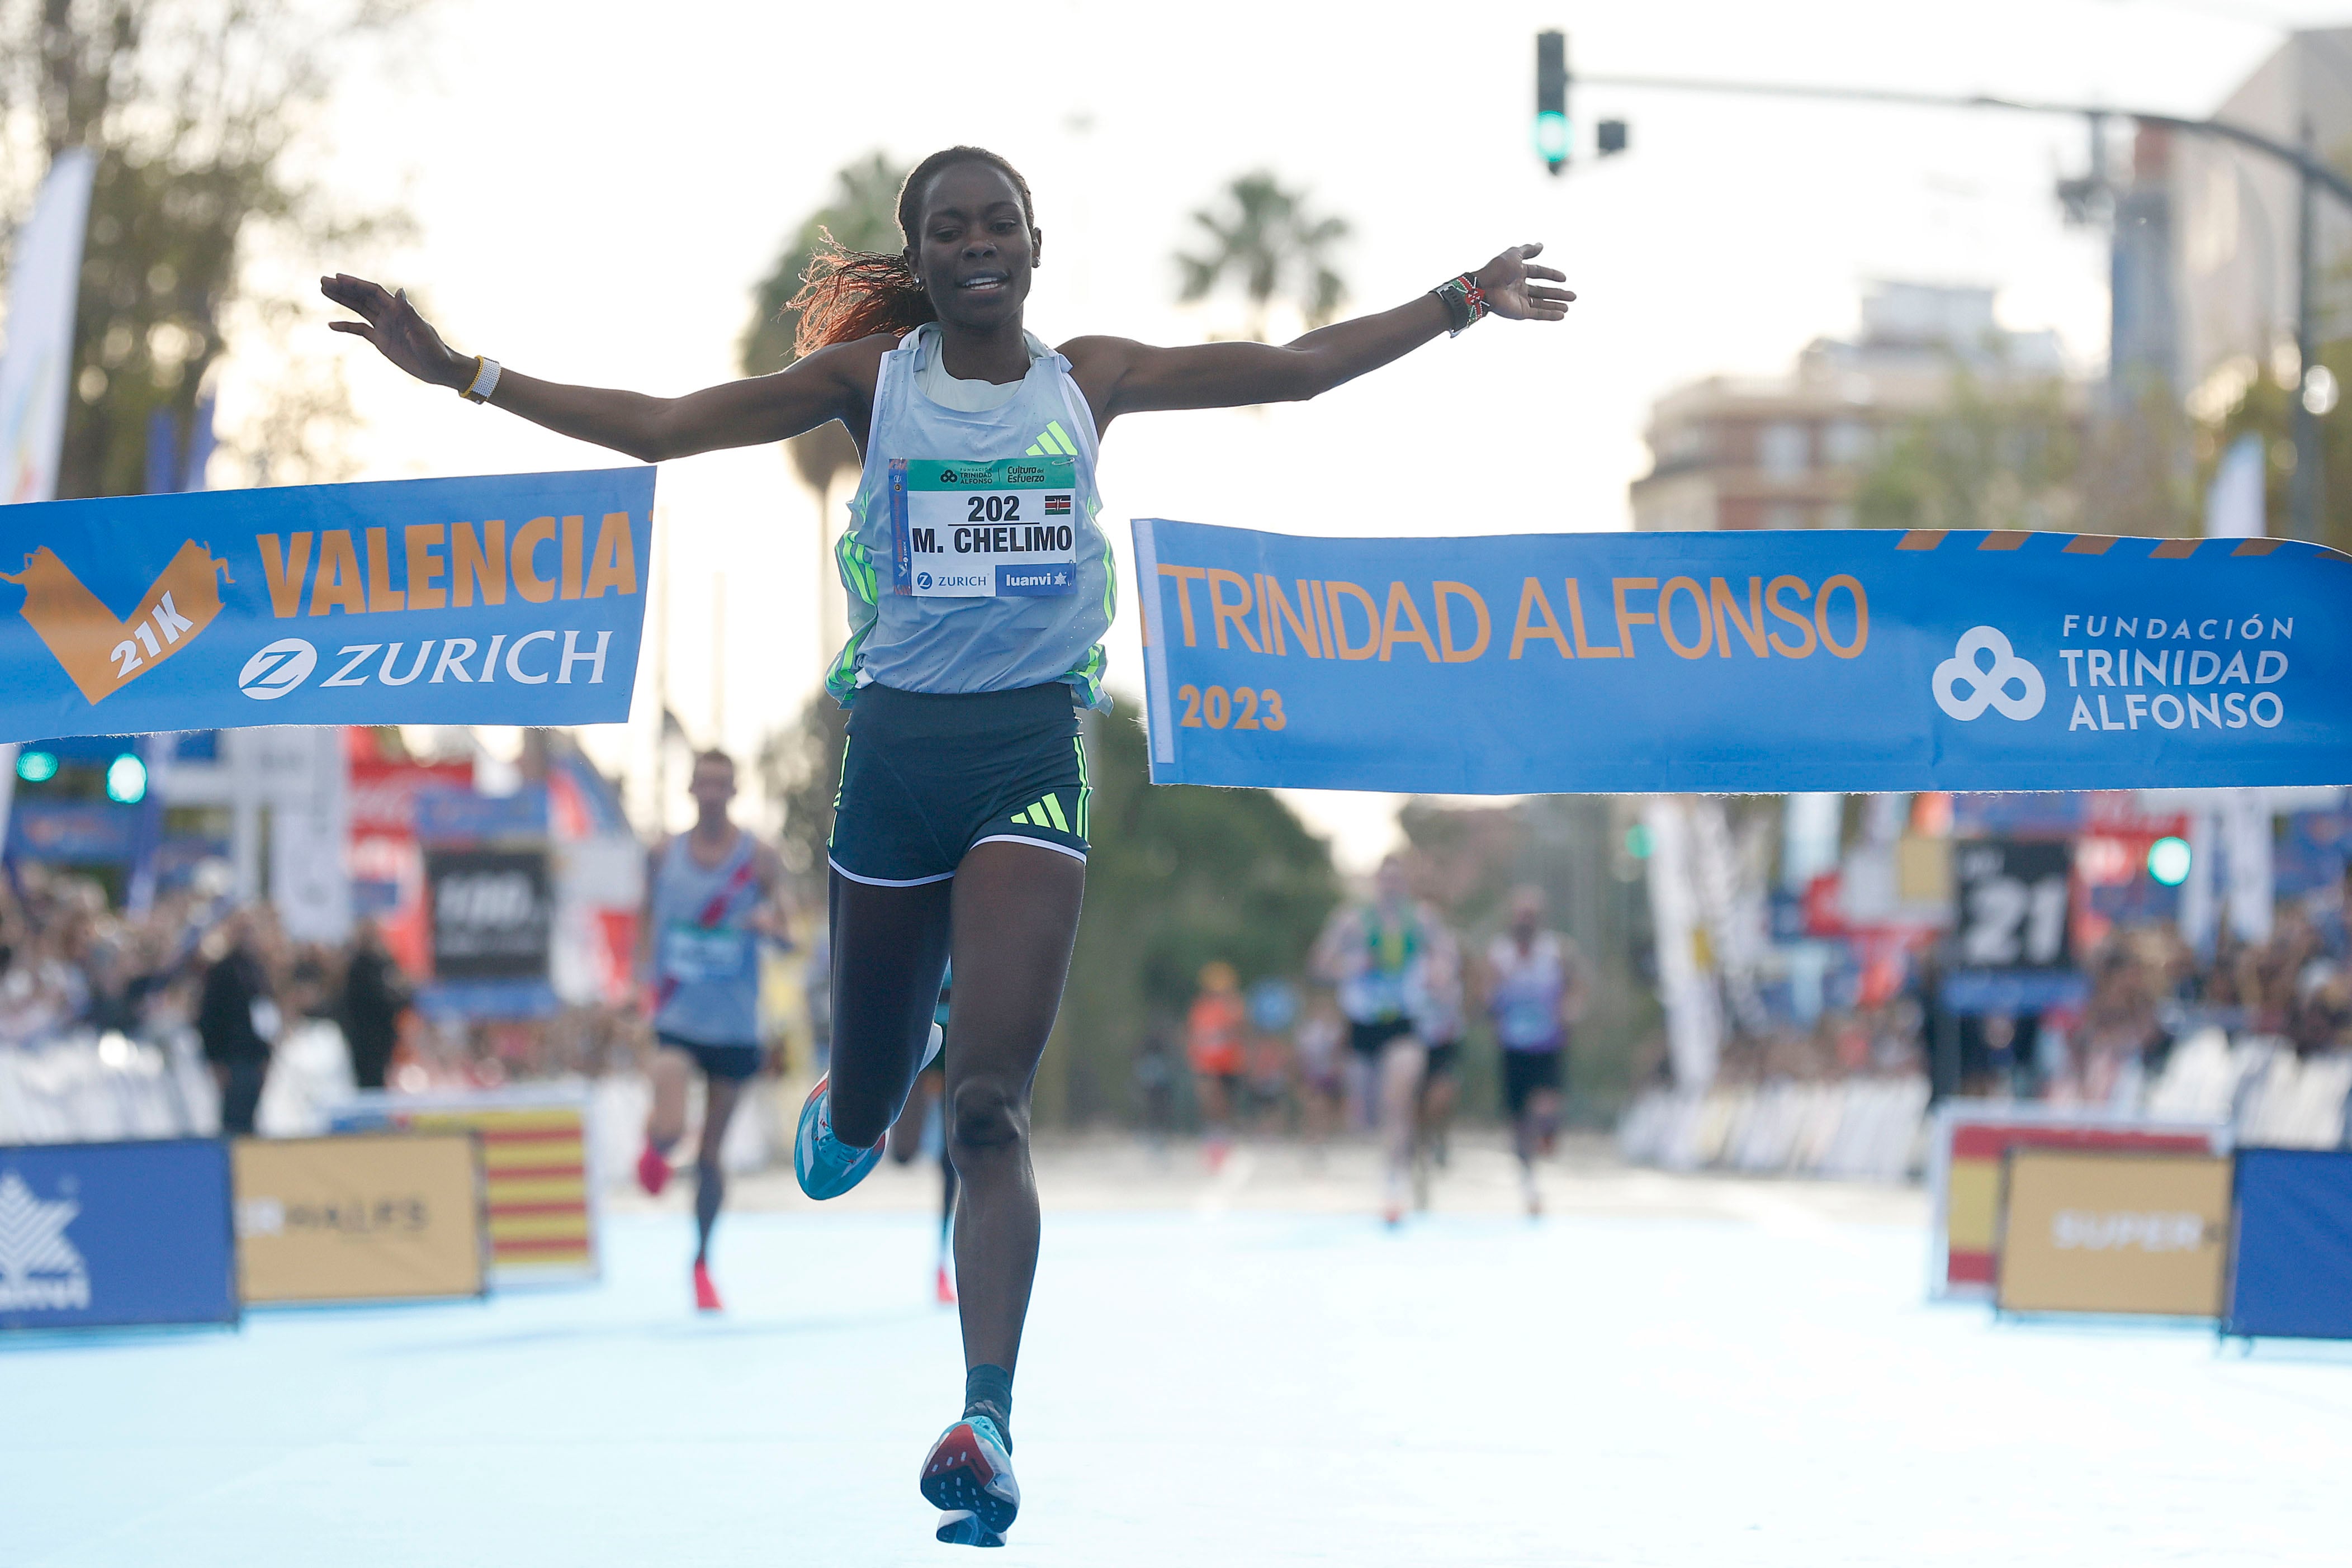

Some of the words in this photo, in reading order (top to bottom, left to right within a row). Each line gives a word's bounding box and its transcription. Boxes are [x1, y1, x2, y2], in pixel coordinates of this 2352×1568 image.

[1007, 466, 1037, 474] Cultura
[1007, 474, 1044, 483] Esfuerzo
[968, 495, 1020, 522] 202
[912, 528, 944, 553] M.
[954, 525, 1072, 553] CHELIMO
[257, 511, 637, 618] VALENCIA
[939, 576, 986, 586] ZURICH
[1006, 573, 1051, 587] luanvi
[1157, 563, 1491, 664] TRINIDAD
[1508, 574, 1870, 660] ALFONSO
[2063, 614, 2294, 639] FUNDACIÓN
[110, 591, 194, 679] 21K
[319, 631, 613, 688] ZURICH
[2060, 649, 2289, 687] TRINIDAD
[1178, 684, 1286, 731] 2023
[2068, 691, 2284, 731] ALFONSO
[1967, 877, 2066, 964] 21
